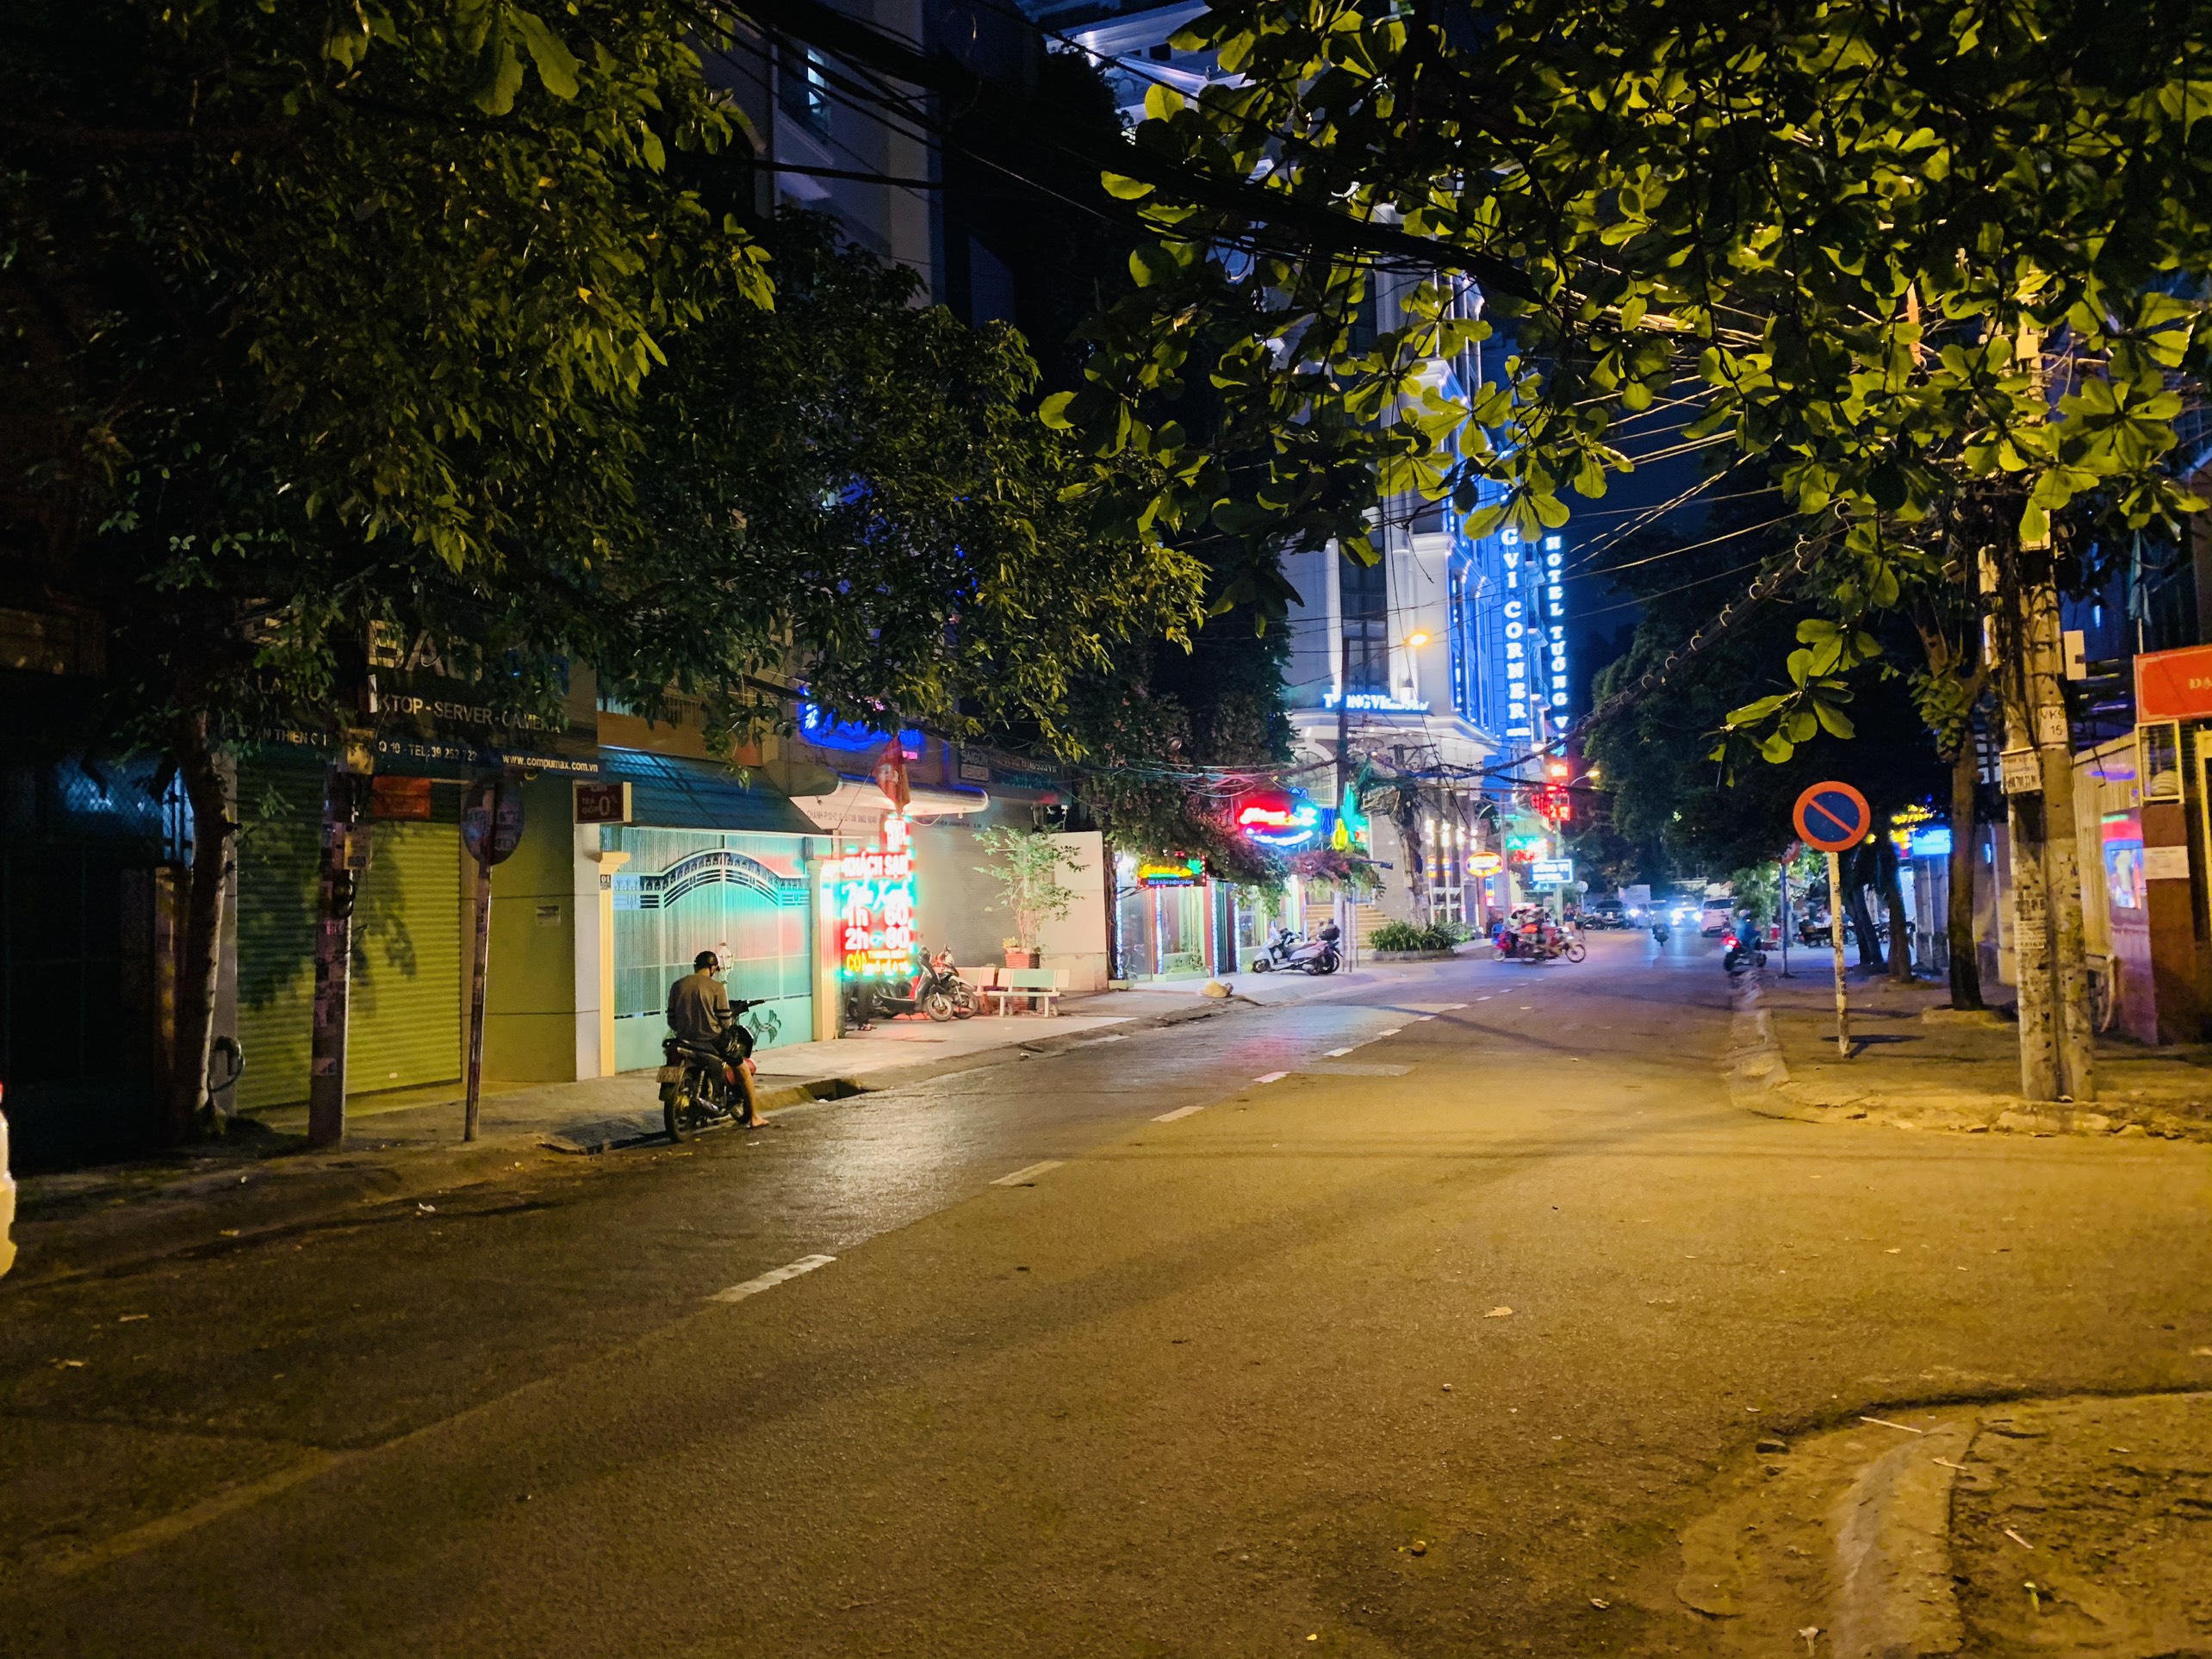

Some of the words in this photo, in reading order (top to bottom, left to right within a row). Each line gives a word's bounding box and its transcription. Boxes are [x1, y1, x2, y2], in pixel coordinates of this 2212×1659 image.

[1545, 536, 1563, 617] HOTEL
[1504, 601, 1526, 718] CORNER
[433, 701, 494, 725] SERVER
[2051, 724, 2063, 736] 15
[502, 754, 600, 774] www.compumax.com.vn
[884, 905, 910, 927] 60
[844, 926, 869, 950] 2h
[884, 926, 910, 950] 80
